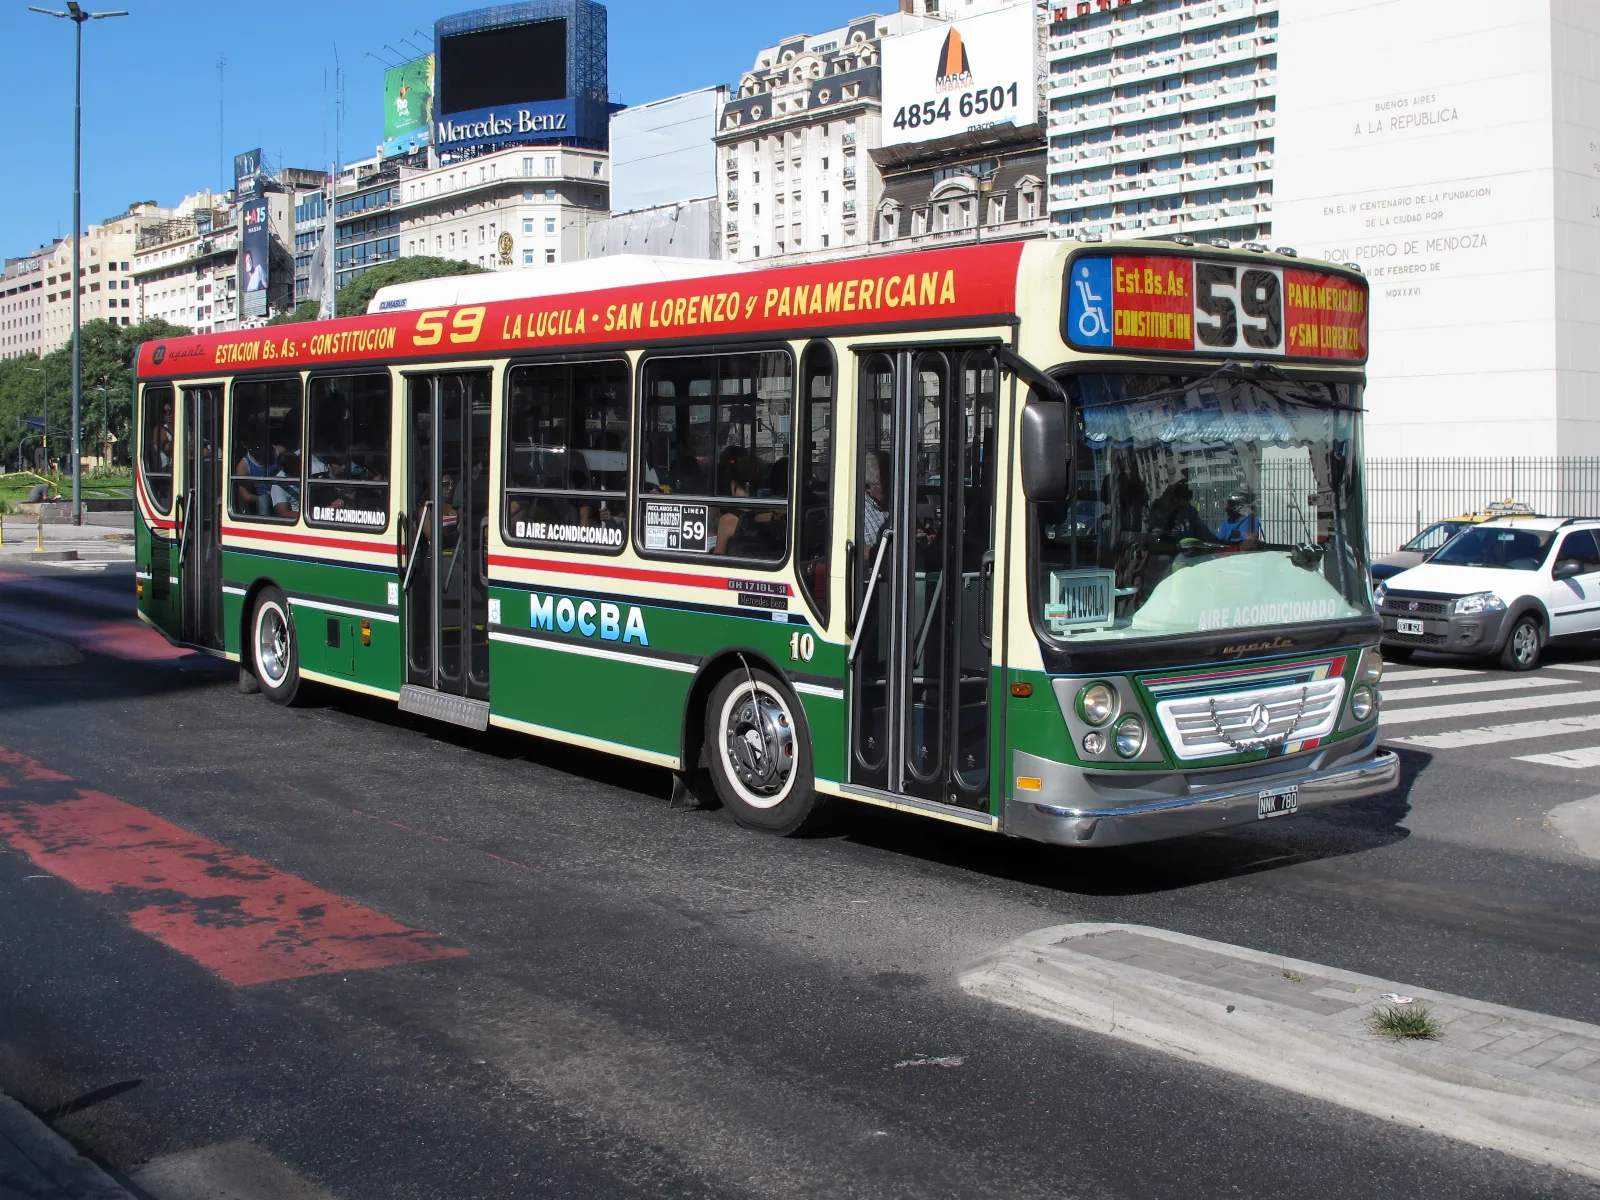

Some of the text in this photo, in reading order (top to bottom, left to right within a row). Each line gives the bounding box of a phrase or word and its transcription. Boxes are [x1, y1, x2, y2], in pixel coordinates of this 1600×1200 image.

[935, 78, 975, 95] URBANA
[936, 71, 973, 86] MARCA
[893, 81, 1018, 131] 4854 6501
[1375, 94, 1436, 112] BUENOS AIRES
[438, 109, 567, 144] Mercedes-Benz
[1355, 107, 1459, 136] A LA REPUBLICA
[1323, 188, 1491, 216] EN EL IV CENTENARIO DE LA FUNDACION
[1366, 211, 1444, 228] DE LA CIUDAD POR
[1324, 234, 1488, 263] DON PEDRO DE MENDOZA
[1374, 267, 1385, 276] DE
[1387, 263, 1427, 275] FEBRERO
[1430, 262, 1441, 272] DE
[1196, 262, 1282, 349] 59
[1288, 282, 1364, 315] PANAMERICANA
[1386, 287, 1421, 298] MDXXXVI
[215, 340, 261, 364] ESTACION
[262, 340, 279, 360] Bs.
[280, 337, 299, 359] As.
[309, 327, 397, 355] CONSTITUCION
[412, 306, 487, 346] 59
[502, 315, 521, 340] LA
[526, 308, 586, 338] LUCILA
[603, 302, 644, 332] SAN
[649, 291, 741, 328] LORENZO
[763, 269, 957, 318] PANAMERICANA
[1114, 309, 1192, 340] CONSTITUCION
[1298, 323, 1318, 347] SAN
[1320, 325, 1359, 350] LORENZO
[320, 507, 386, 526] AIRE ACONDICIONADO
[683, 507, 705, 515] LINEA
[526, 522, 622, 546] AIRE ACONDICIONADO
[668, 534, 677, 547] 10
[682, 520, 705, 540] 59
[740, 594, 786, 608] Mercedes-Benz
[1078, 584, 1105, 618] LUCILA
[529, 593, 650, 646] MOCBA
[1198, 599, 1337, 631] AIRE ACONDICIONADO
[789, 631, 815, 662] 10
[1260, 793, 1297, 814] NNK 780
